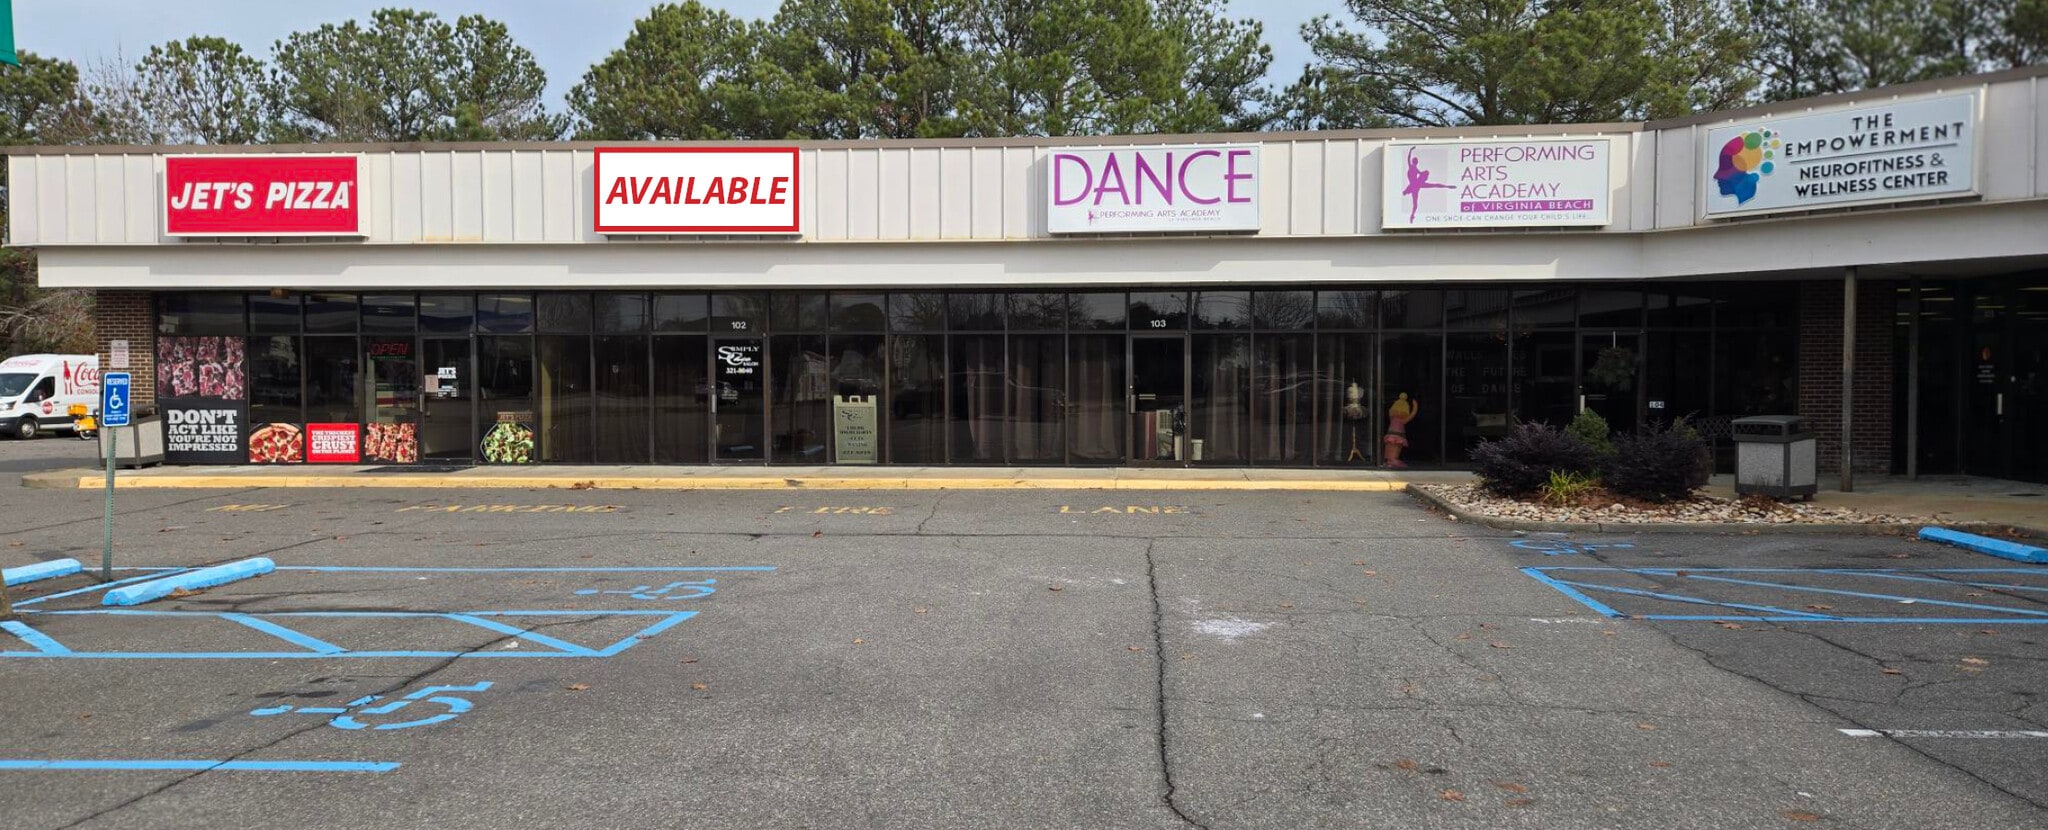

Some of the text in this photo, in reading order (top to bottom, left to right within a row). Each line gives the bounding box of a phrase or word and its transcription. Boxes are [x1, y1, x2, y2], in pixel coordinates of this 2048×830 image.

[1852, 112, 1894, 131] THE
[1785, 122, 1965, 157] EMPOWERMENT
[1460, 144, 1595, 163] PERFORMING
[1460, 165, 1508, 182] ARTS
[1800, 152, 1944, 181] NEUROFITNESS &
[1054, 150, 1253, 206] DANCE
[1794, 171, 1948, 197] WELLNESS CENTER
[171, 181, 350, 210] JET'S PIZZA
[1460, 183, 1561, 200] ACADEMY
[1463, 200, 1591, 212] of VIRGINIA BEACH
[1100, 210, 1154, 218] PERFORMING
[1180, 209, 1220, 217] ACADEMY
[731, 321, 747, 330] 102
[1150, 320, 1167, 328] 103
[368, 343, 408, 355] OPEN
[167, 409, 238, 425] DON'T
[168, 425, 238, 435] ACT LIKE
[168, 435, 238, 443] YOU'RE NOT
[311, 440, 357, 450] CRUST
[168, 443, 238, 452] IMPRESSED
[1057, 504, 1192, 514] LANE
